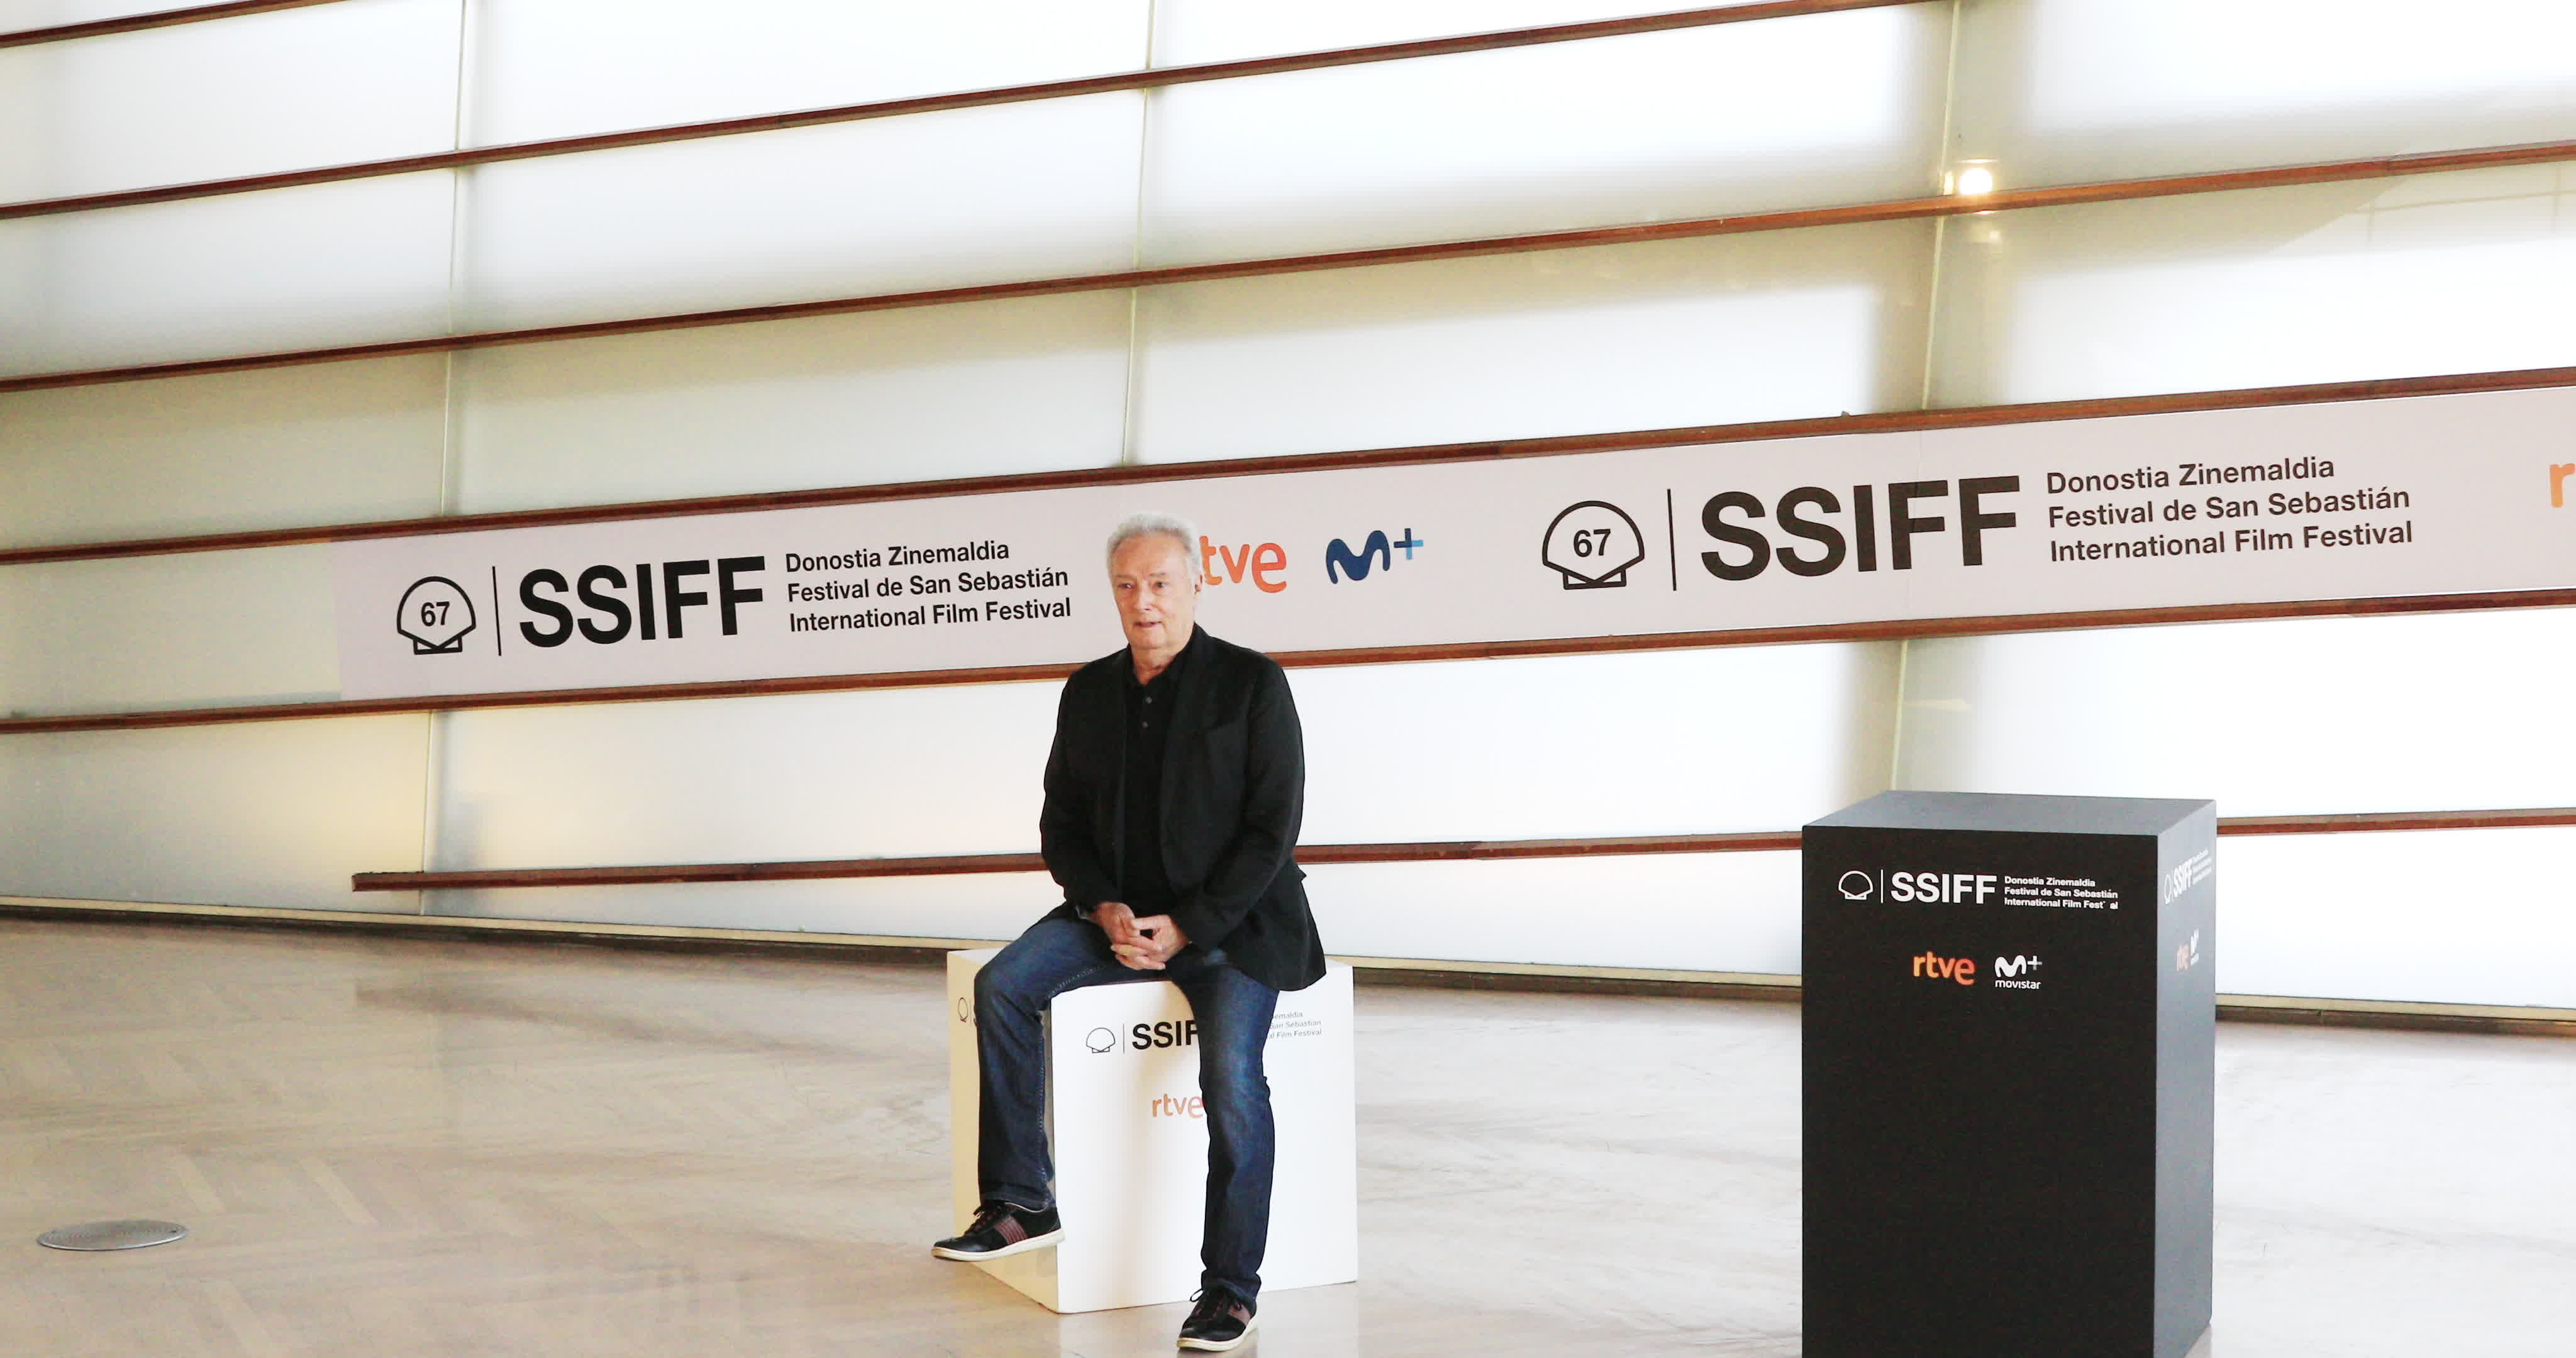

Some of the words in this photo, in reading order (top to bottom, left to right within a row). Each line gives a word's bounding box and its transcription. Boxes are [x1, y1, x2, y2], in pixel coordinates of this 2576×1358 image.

[2047, 466, 2169, 494] Donostia
[2179, 456, 2334, 486] Zinemaldia
[2049, 500, 2153, 528] Festival
[2163, 499, 2197, 521] de
[2206, 496, 2258, 519] San
[2268, 486, 2409, 516] Sebastián
[1573, 528, 1611, 558] 67
[1701, 475, 2020, 581] SSIFF
[2051, 531, 2224, 562] International
[2235, 529, 2293, 552] Film
[2303, 520, 2412, 548] Festival
[786, 548, 881, 573] Donostia
[888, 540, 1009, 566] Zinemaldia
[1199, 535, 1287, 593] tve
[788, 578, 869, 602] Festival
[877, 577, 903, 597] de
[910, 575, 951, 595] San
[958, 566, 1069, 592] Sebastián
[421, 601, 450, 627] 67
[519, 556, 765, 648] SSIFF
[791, 605, 925, 632] International
[933, 604, 979, 624] Film
[985, 597, 1071, 621] Festival
[1890, 871, 1997, 904] SSIFF
[2004, 876, 2044, 885] Donostia
[2046, 877, 2096, 887] Zinemaldia
[2004, 886, 2039, 896] Festival
[2040, 888, 2052, 897] de
[2053, 888, 2072, 897] San
[2073, 888, 2118, 899] Sebastián
[2004, 897, 2061, 907] International
[2062, 899, 2082, 908] Film
[1913, 951, 1976, 986] rtve
[1995, 979, 2041, 990] movistar
[1131, 1019, 1199, 1051] SSIF
[1152, 1093, 1204, 1118] rtve
